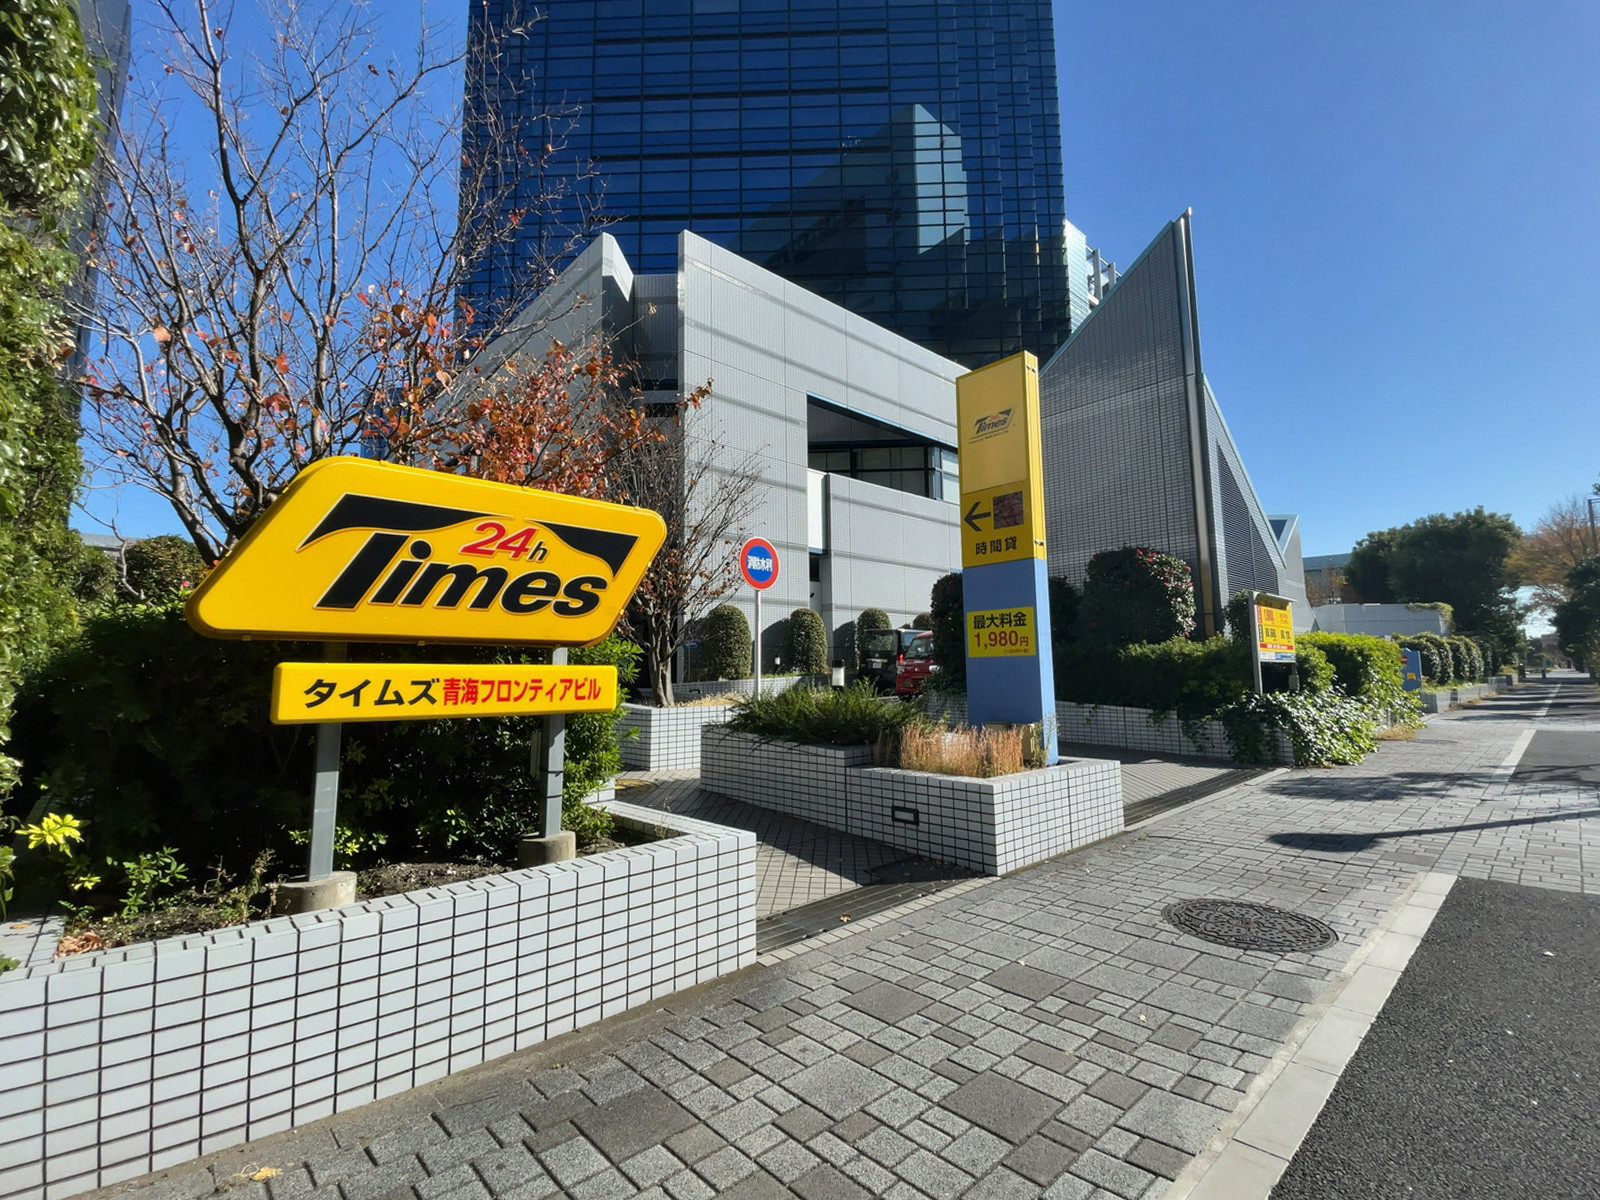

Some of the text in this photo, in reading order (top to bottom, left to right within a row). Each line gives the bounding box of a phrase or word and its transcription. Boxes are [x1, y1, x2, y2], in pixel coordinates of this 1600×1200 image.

[461, 521, 549, 562] 24h
[975, 536, 1017, 556] 時間貸
[297, 493, 610, 618] Times
[974, 611, 1027, 629] 最大料金
[975, 630, 1029, 650] 1,980円
